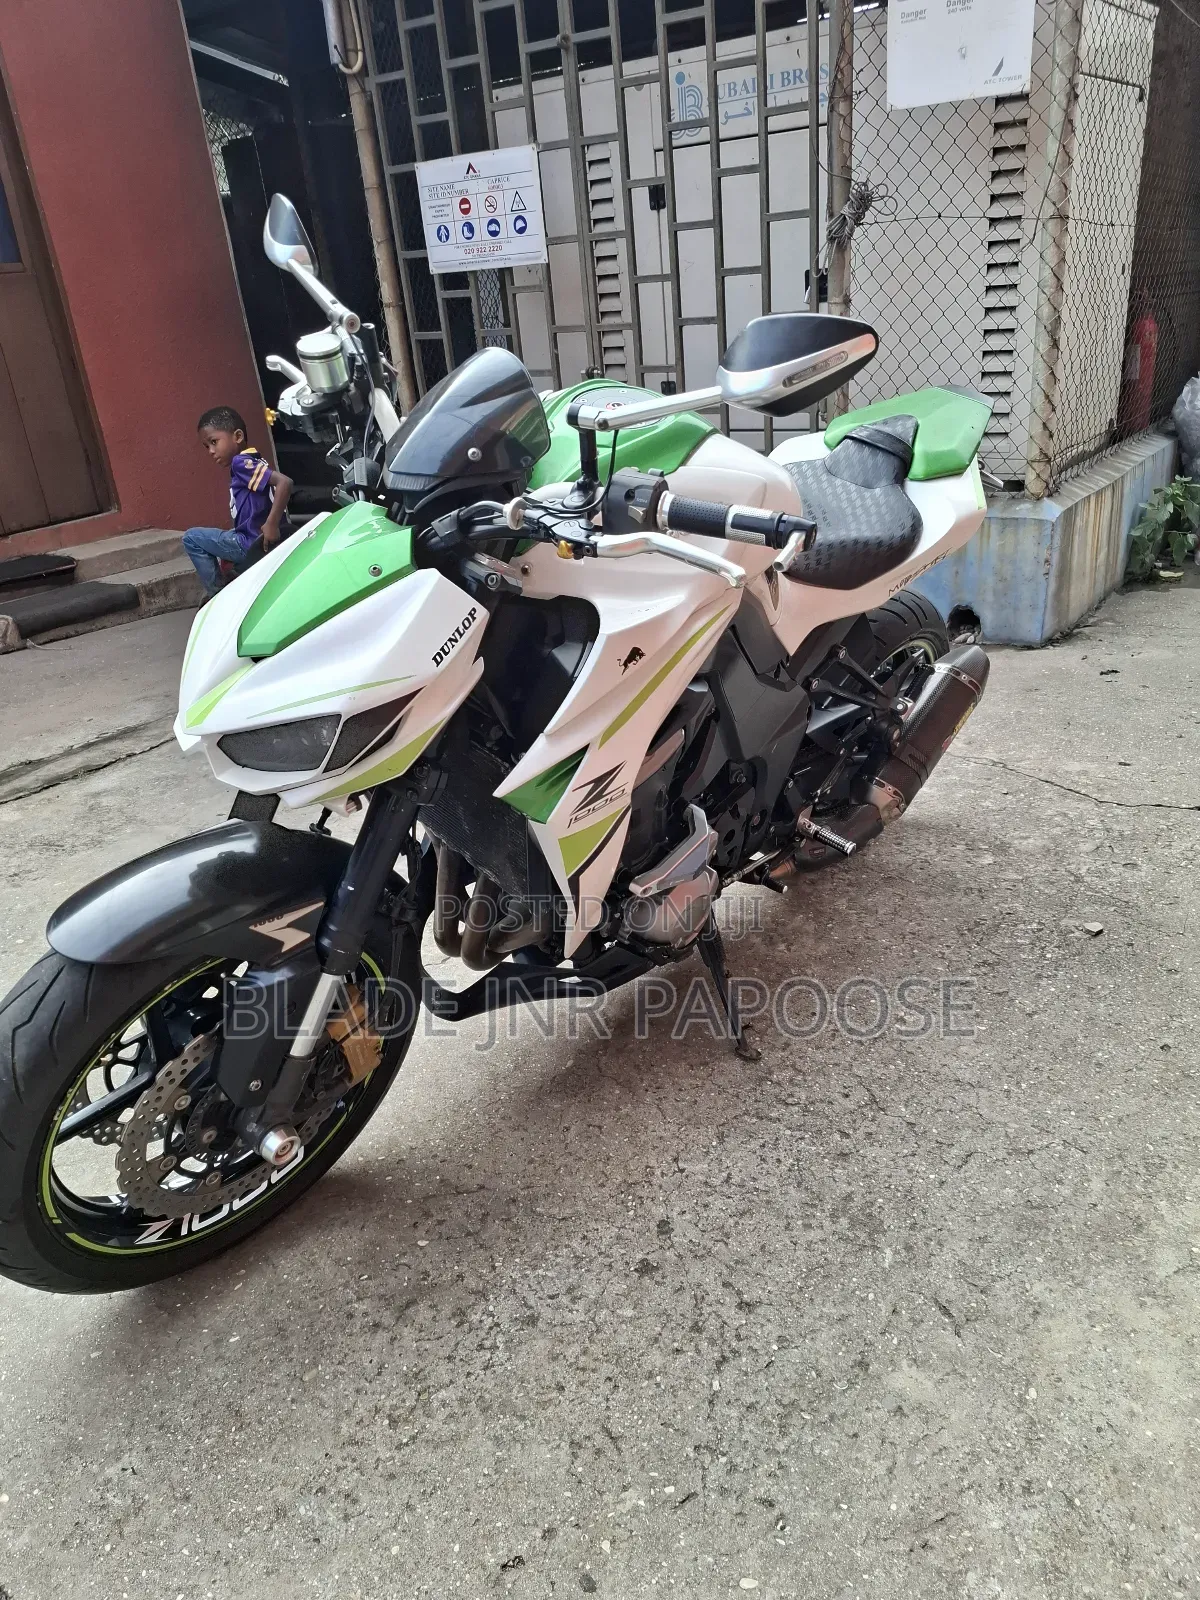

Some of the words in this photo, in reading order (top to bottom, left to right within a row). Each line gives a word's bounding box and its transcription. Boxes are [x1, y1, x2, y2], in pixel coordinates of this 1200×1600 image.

[900, 8, 927, 19] Danger
[780, 62, 829, 88] BRS
[998, 74, 1023, 83] TOWER
[427, 186, 439, 194] SITE
[439, 183, 455, 192] NAME
[447, 188, 469, 197] NUMBER
[475, 246, 487, 254] 922
[431, 606, 478, 668] DUNLOP
[566, 787, 628, 830] 1000
